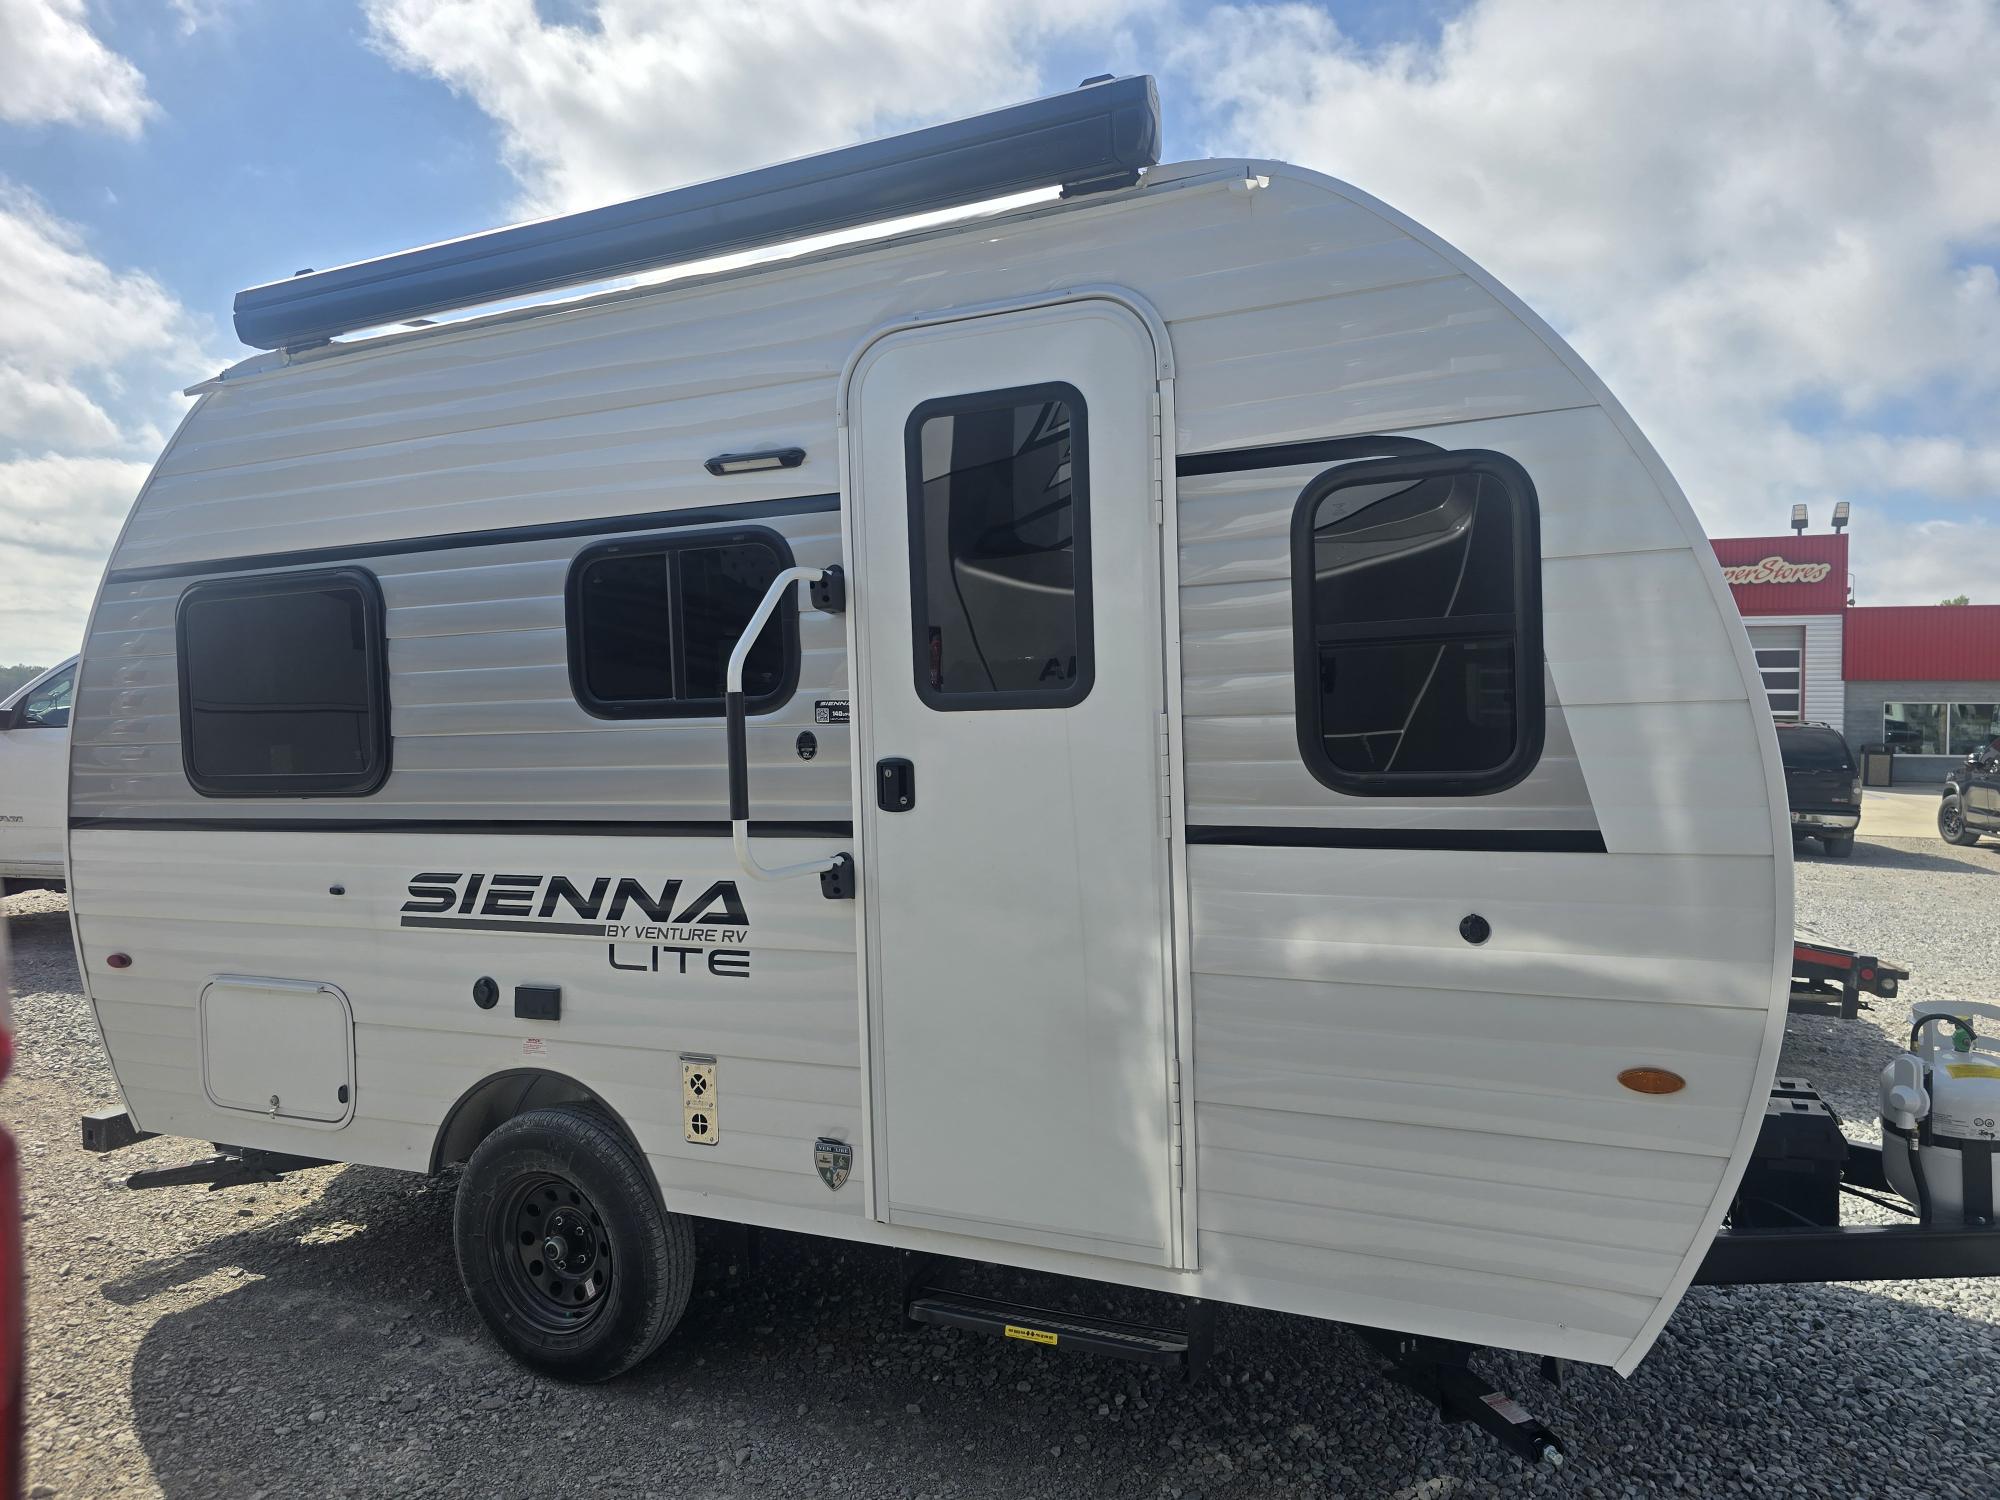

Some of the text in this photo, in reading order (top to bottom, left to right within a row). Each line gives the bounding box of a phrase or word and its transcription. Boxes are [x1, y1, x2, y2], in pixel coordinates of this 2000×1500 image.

[400, 872, 750, 926] SIENNA
[606, 924, 748, 944] BY VENTURE RV
[608, 943, 751, 978] LITE
